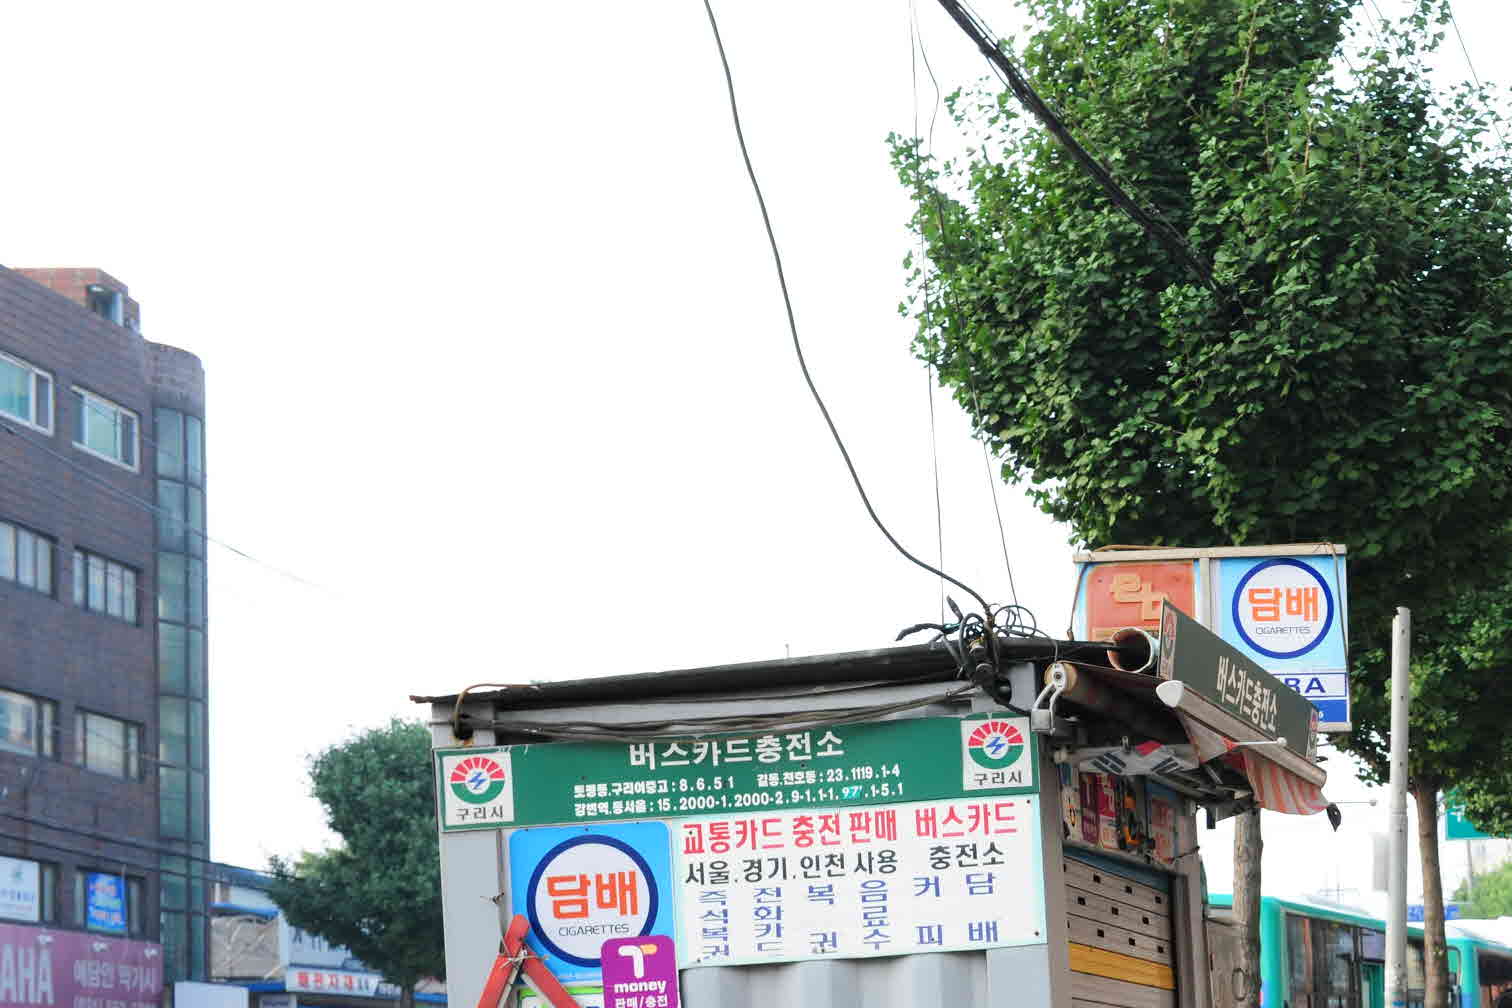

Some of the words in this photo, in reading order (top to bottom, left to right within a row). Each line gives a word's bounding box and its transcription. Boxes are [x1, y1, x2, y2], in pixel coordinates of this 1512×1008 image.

[1247, 587, 1319, 622] 담배
[1255, 626, 1312, 636] CIGARETTES
[1216, 655, 1277, 732] 버스카드충전소
[629, 731, 845, 770] 버스카드충전소
[974, 770, 1022, 786] 구리시
[456, 805, 504, 821] 구리시
[915, 802, 1018, 840] 버스카드
[682, 817, 785, 855] 교통카드
[792, 814, 842, 848] 충전
[849, 809, 898, 844] 판매
[853, 849, 899, 875] 사용
[929, 841, 1006, 870] 충전소
[547, 870, 639, 919] 담배
[558, 923, 630, 938] CIGARETTES
[614, 979, 667, 994] money
